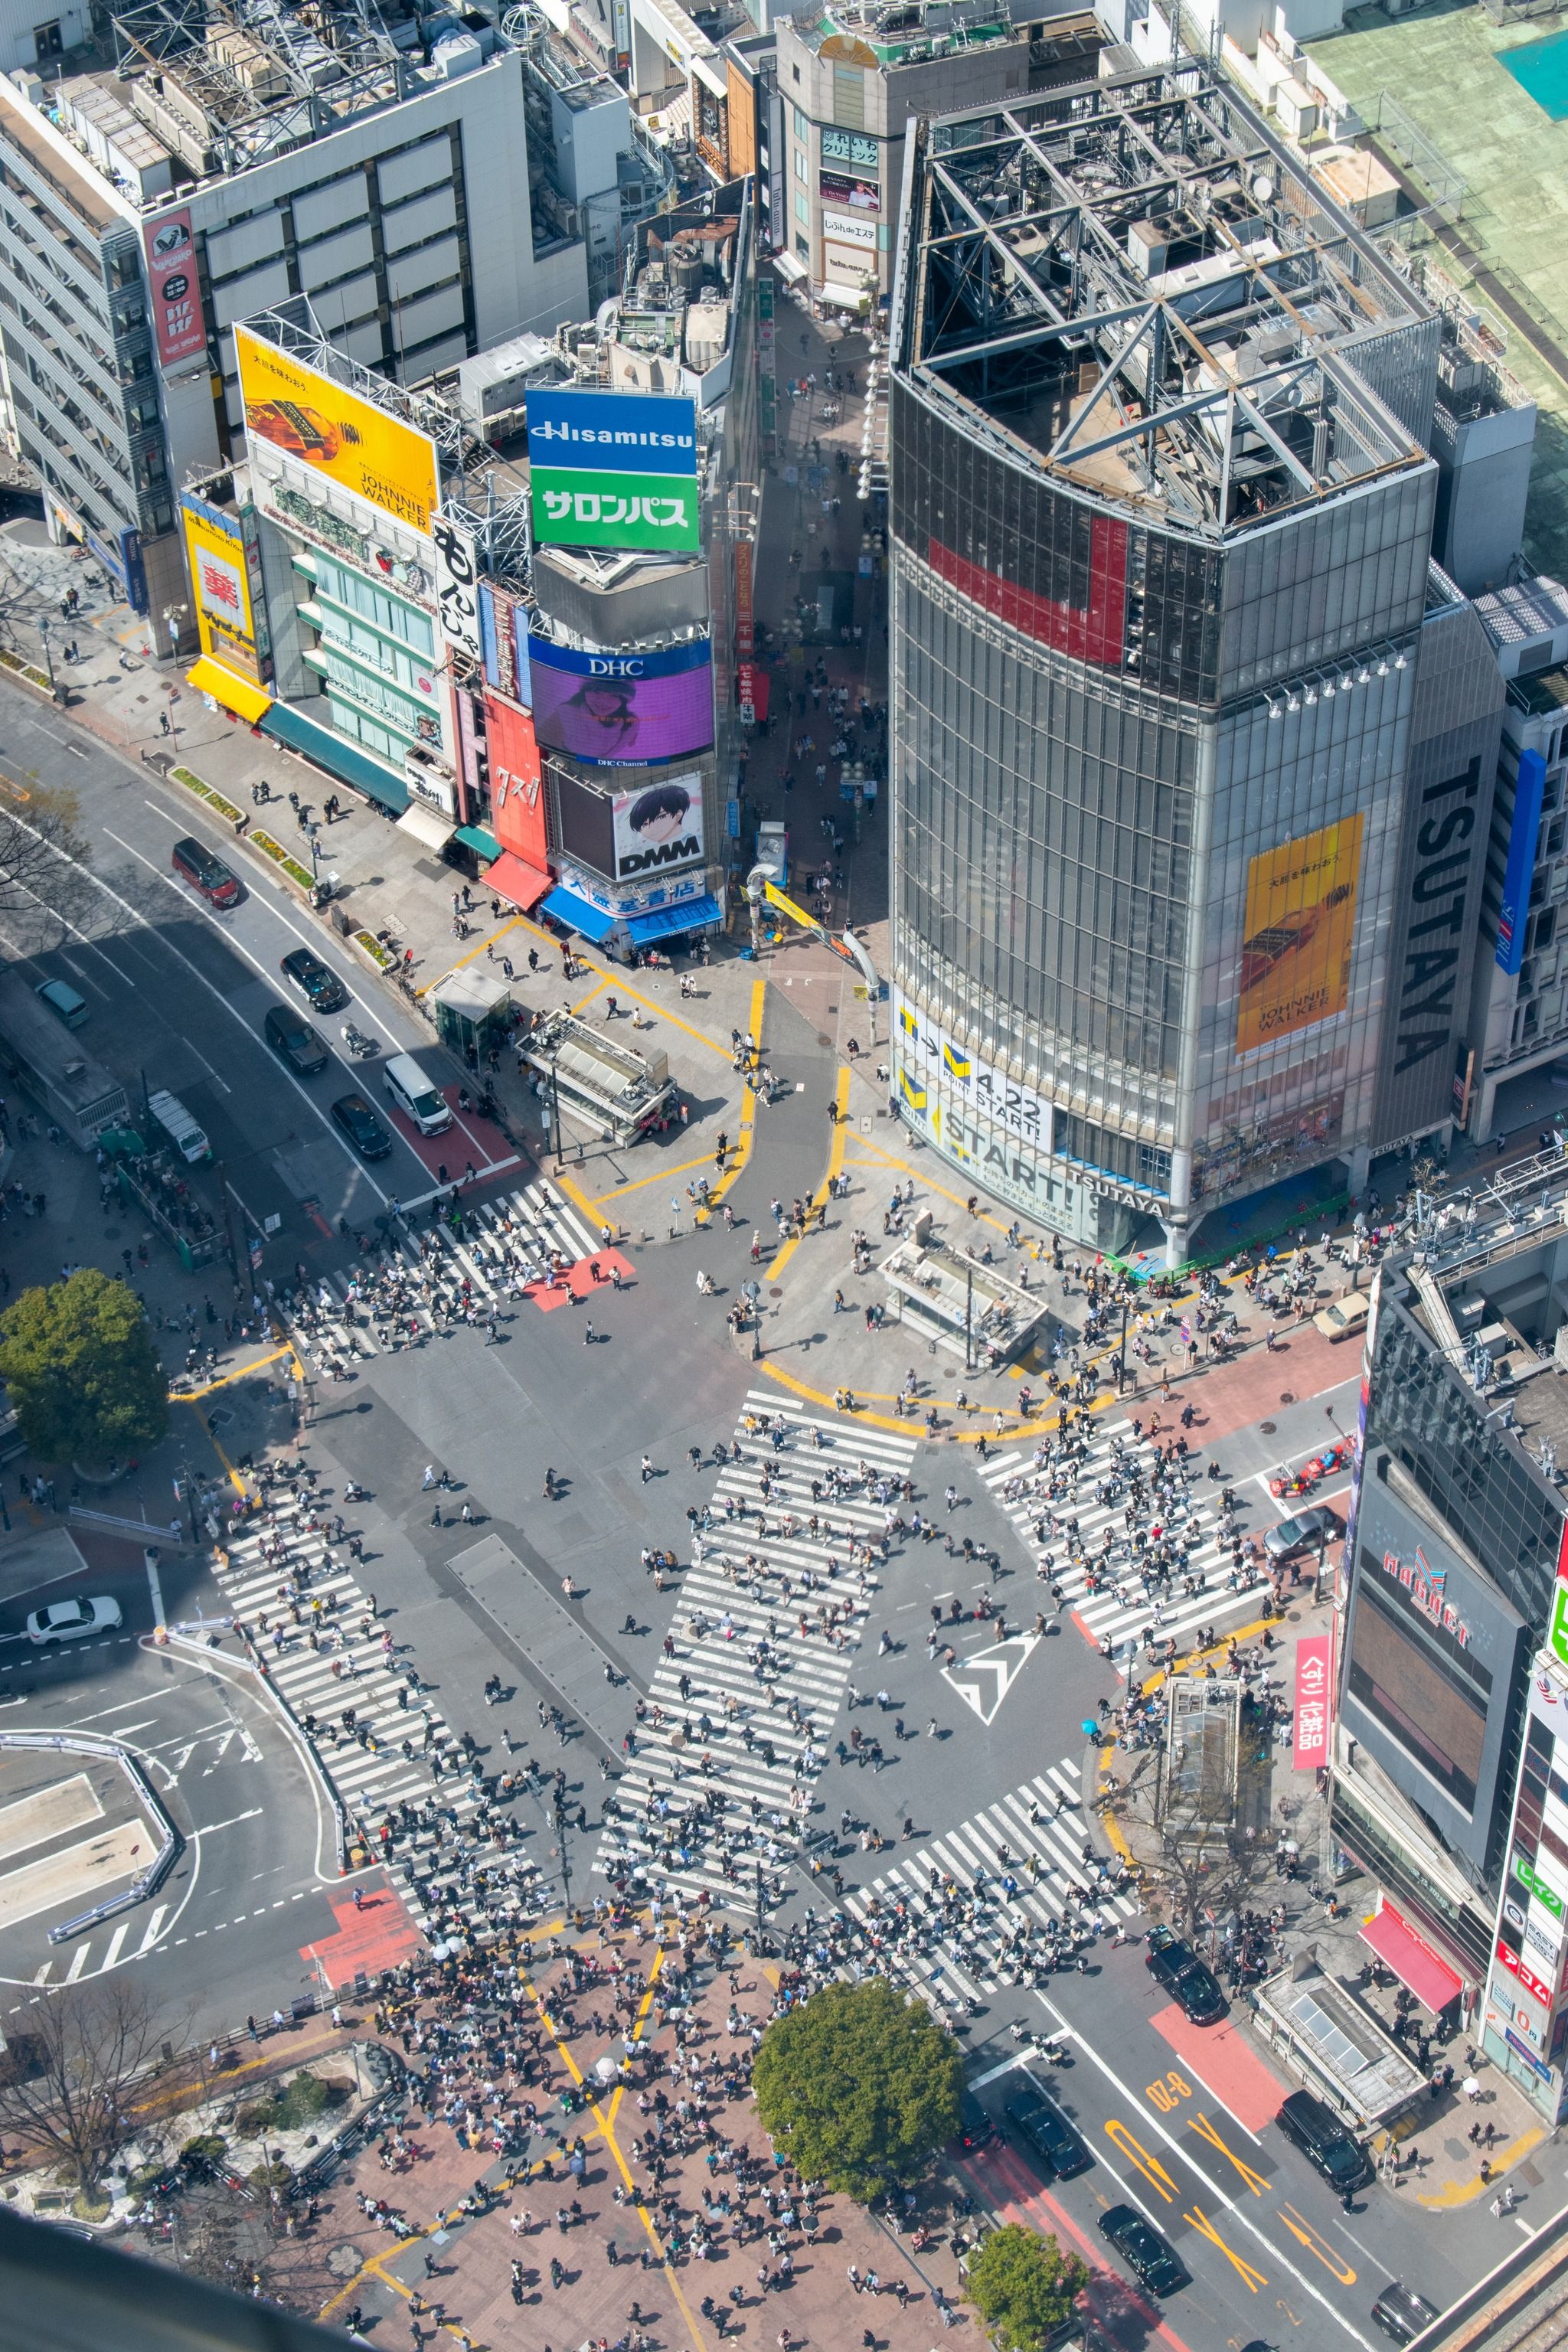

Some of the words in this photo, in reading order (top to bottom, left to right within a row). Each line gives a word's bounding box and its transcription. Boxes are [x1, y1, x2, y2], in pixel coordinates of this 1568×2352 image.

[823, 143, 877, 163] クリニック
[837, 133, 877, 151] れいわ
[165, 300, 191, 322] B1F
[167, 315, 193, 338] B2F
[531, 421, 693, 448] Hisamitsu
[361, 472, 426, 518] JOHNNIE
[361, 482, 426, 531] WALKER
[542, 490, 688, 528] サロンパス
[128, 536, 137, 561] MIZUHO
[203, 563, 240, 610] 薬
[434, 524, 479, 656] もんじゃ
[738, 612, 752, 650] 三千里
[590, 658, 643, 676] DHC
[619, 835, 700, 876] DMM
[1394, 754, 1482, 1077] TSUTAYA
[1259, 986, 1331, 1023] JOHNNIE
[1259, 997, 1329, 1032] WALKER
[943, 1071, 971, 1095] POINT
[899, 1099, 927, 1132] POINT
[975, 1091, 1040, 1140] START!
[946, 1112, 1073, 1212] START!
[1372, 1135, 1413, 1158] TSUTAYA
[1070, 1170, 1164, 1218] TSUTAYA
[1383, 1550, 1472, 1651] MAGNET
[1301, 1656, 1325, 1695] くすり
[1298, 1700, 1325, 1750] 化粧品
[1520, 1865, 1560, 1907] レイク
[1529, 1923, 1557, 1950] EAST
[1505, 1949, 1547, 2002] アコム
[1508, 2034, 1537, 2065] PROMISE
